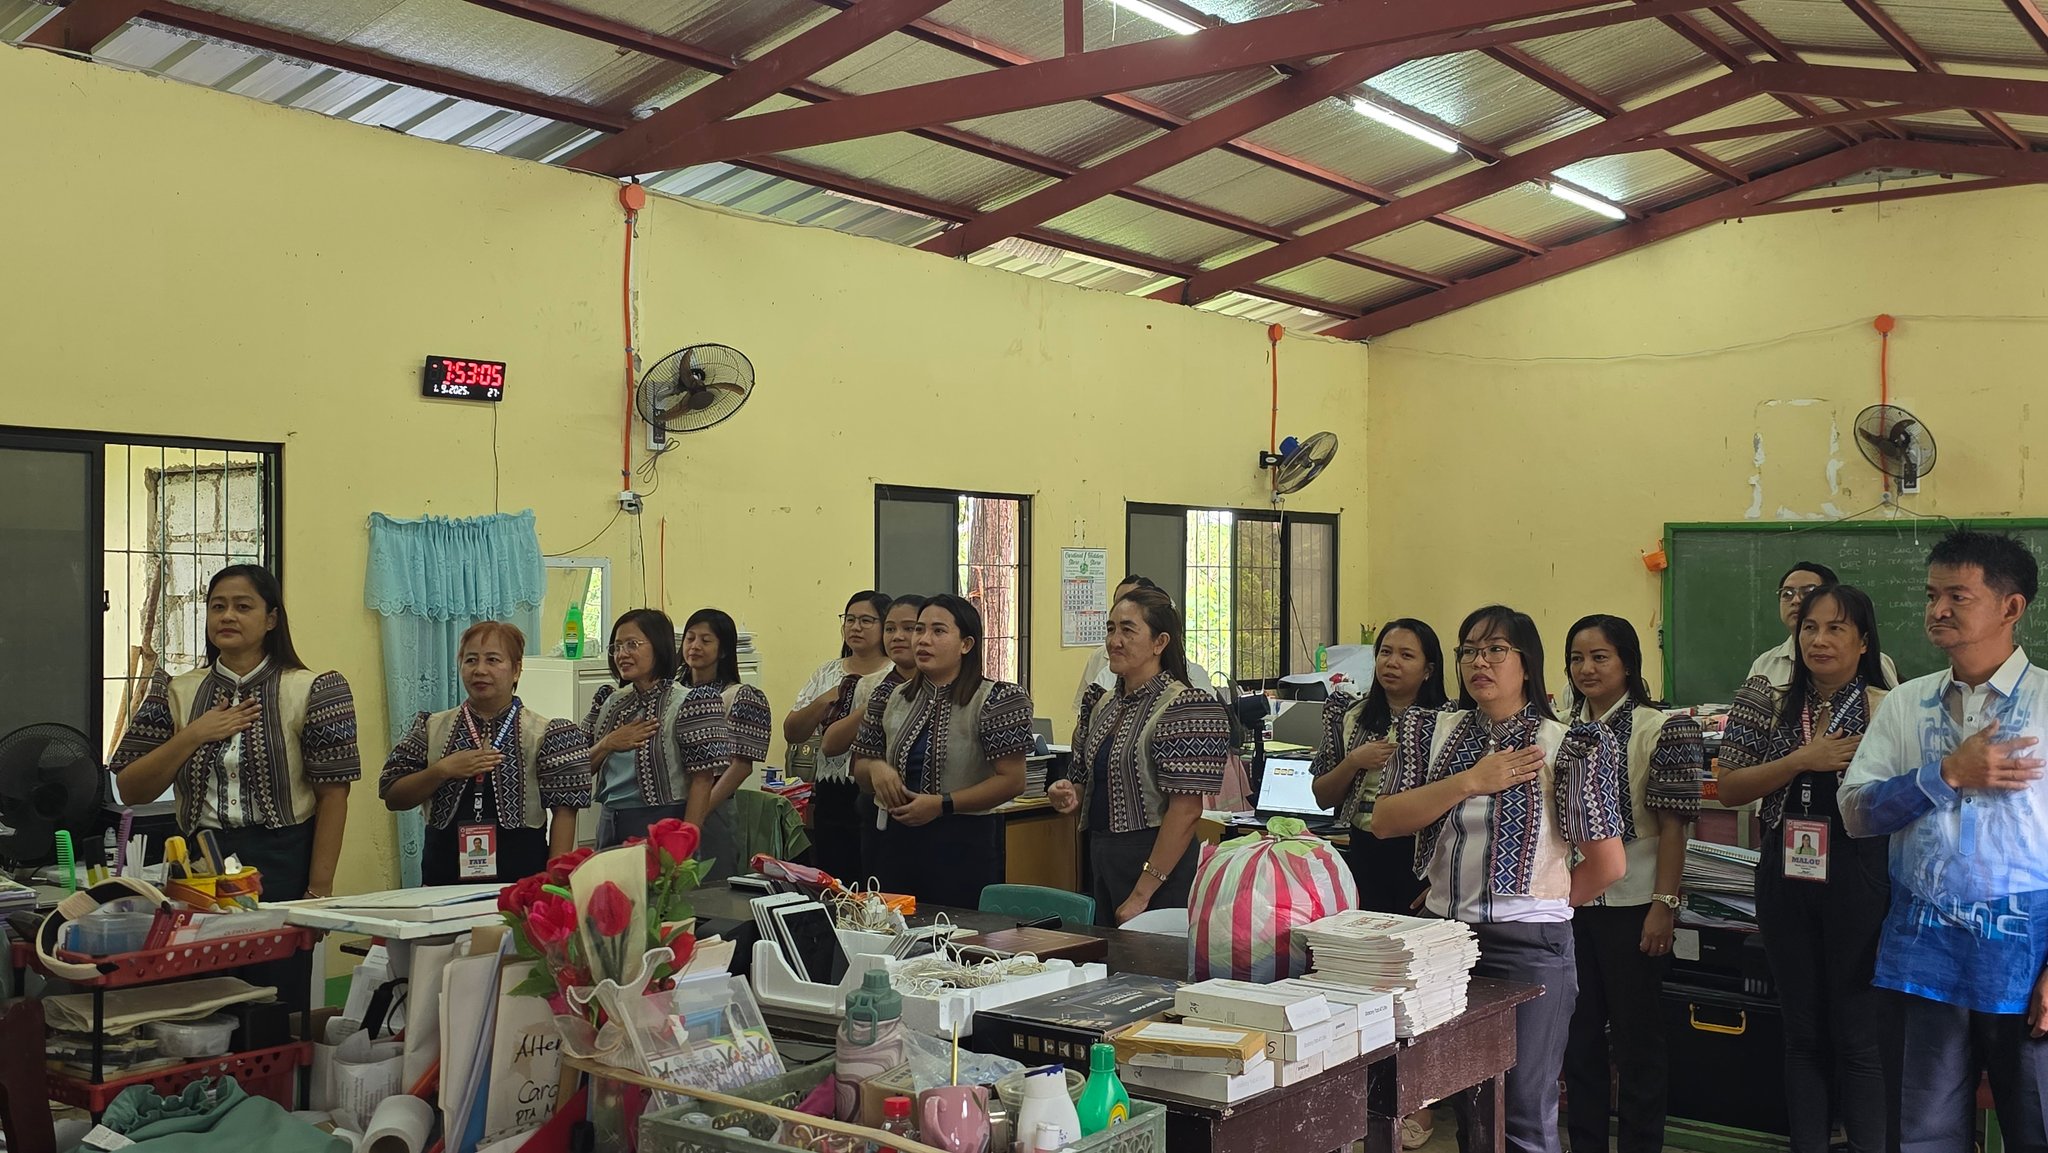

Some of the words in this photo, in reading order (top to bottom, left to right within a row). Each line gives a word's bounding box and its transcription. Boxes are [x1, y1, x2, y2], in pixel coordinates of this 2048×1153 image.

[493, 705, 517, 747] PANGASINAN
[1828, 688, 1861, 733] PANGASINAN
[1791, 856, 1821, 865] MALOU
